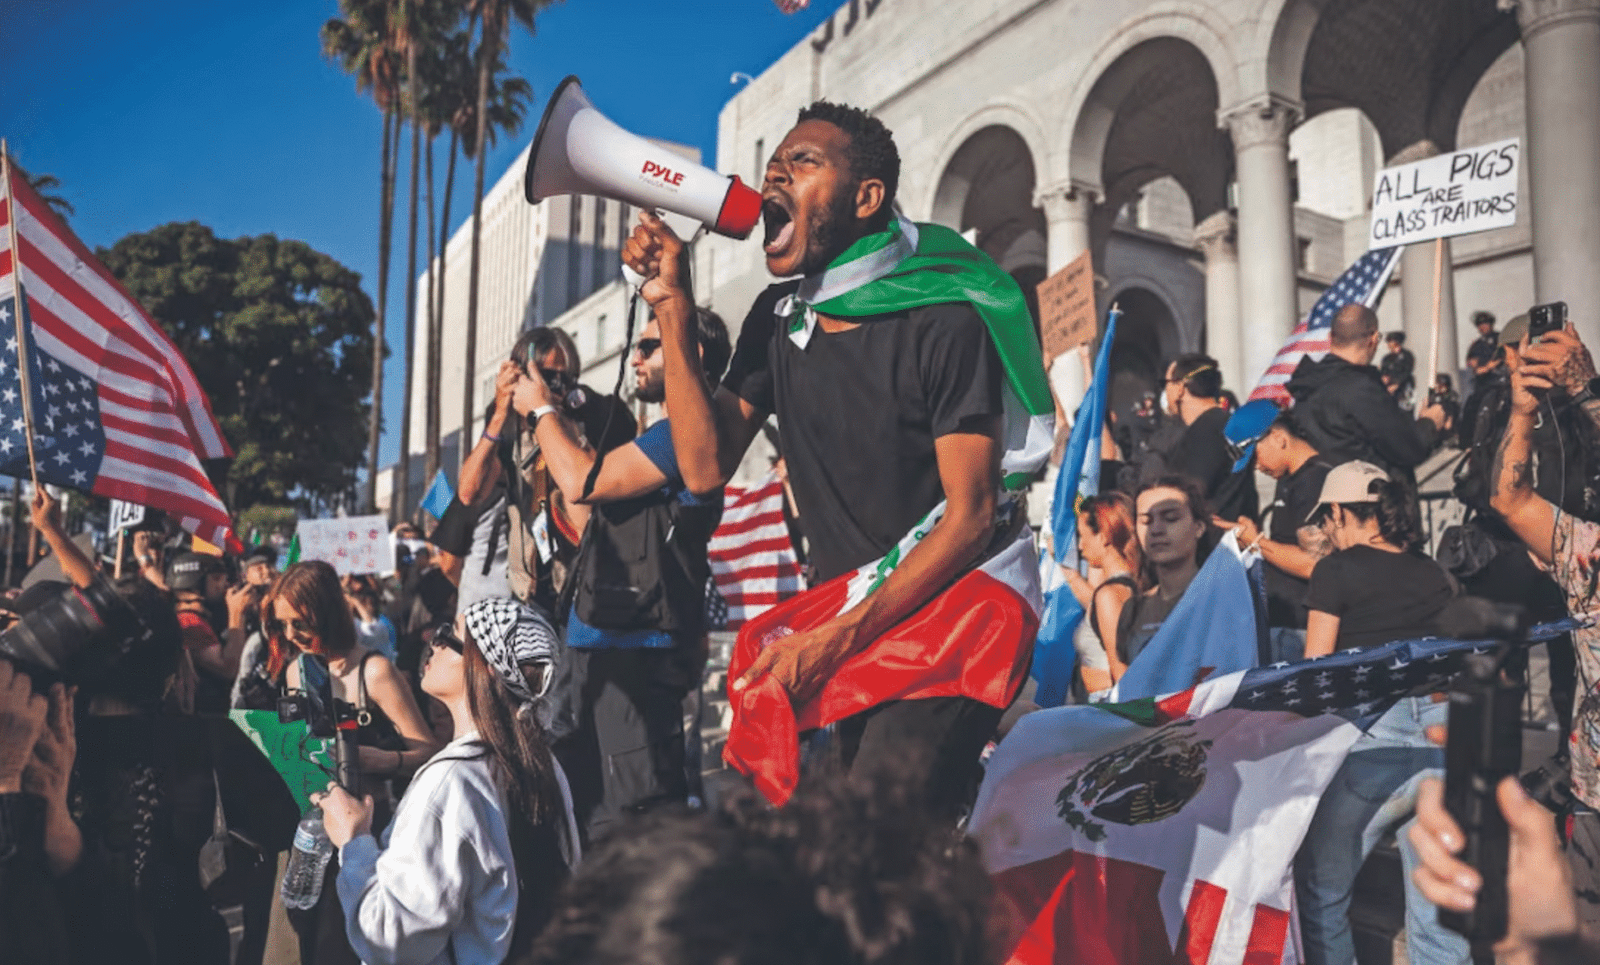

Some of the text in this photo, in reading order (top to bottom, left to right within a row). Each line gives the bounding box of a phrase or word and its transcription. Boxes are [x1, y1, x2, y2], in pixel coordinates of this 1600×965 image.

[1376, 144, 1518, 205] ALL PIGS
[1422, 184, 1463, 206] ARE
[1373, 192, 1516, 240] CLASS TRAITORS
